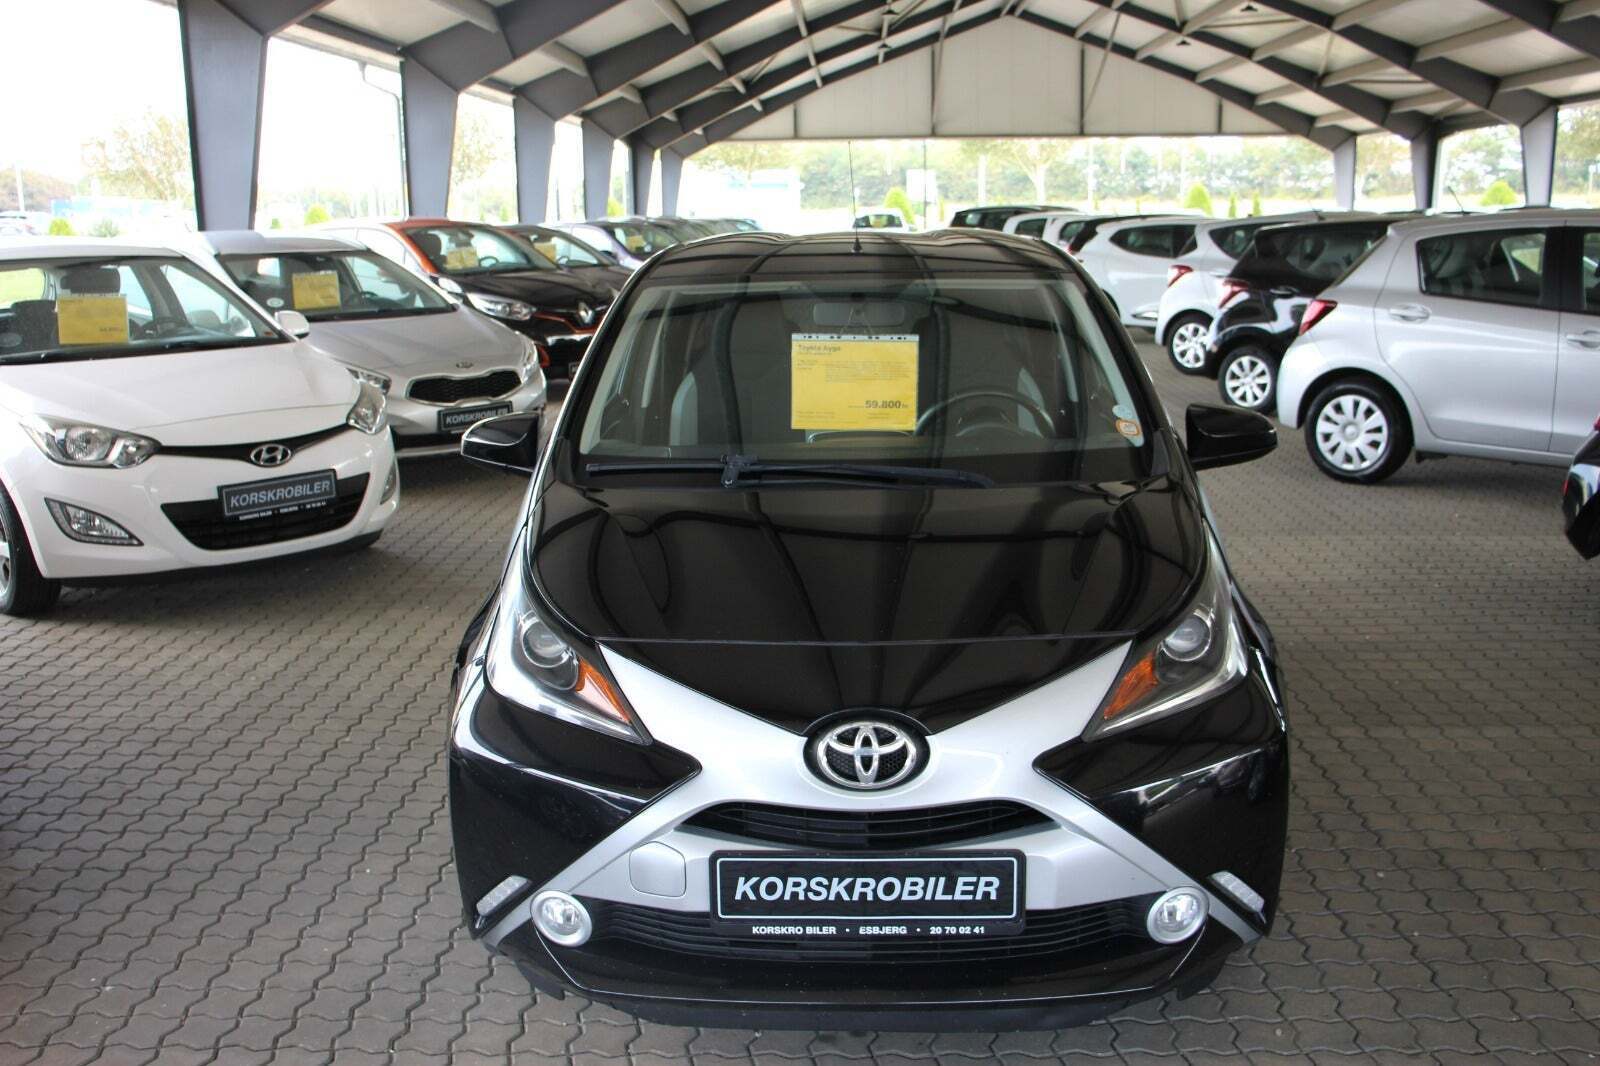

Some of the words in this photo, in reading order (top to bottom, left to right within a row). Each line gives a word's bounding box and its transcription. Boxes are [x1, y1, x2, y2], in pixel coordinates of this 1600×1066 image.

[865, 400, 901, 409] 59.800
[230, 480, 331, 508] KORSKROBILER
[734, 876, 1000, 902] KORSKROBILER
[752, 926, 803, 935] KORSKRO
[805, 926, 836, 935] BILER
[859, 926, 907, 935] ESBJERG
[929, 926, 942, 934] 20
[944, 926, 957, 934] 70
[958, 926, 972, 934] 02
[973, 926, 985, 934] 41
